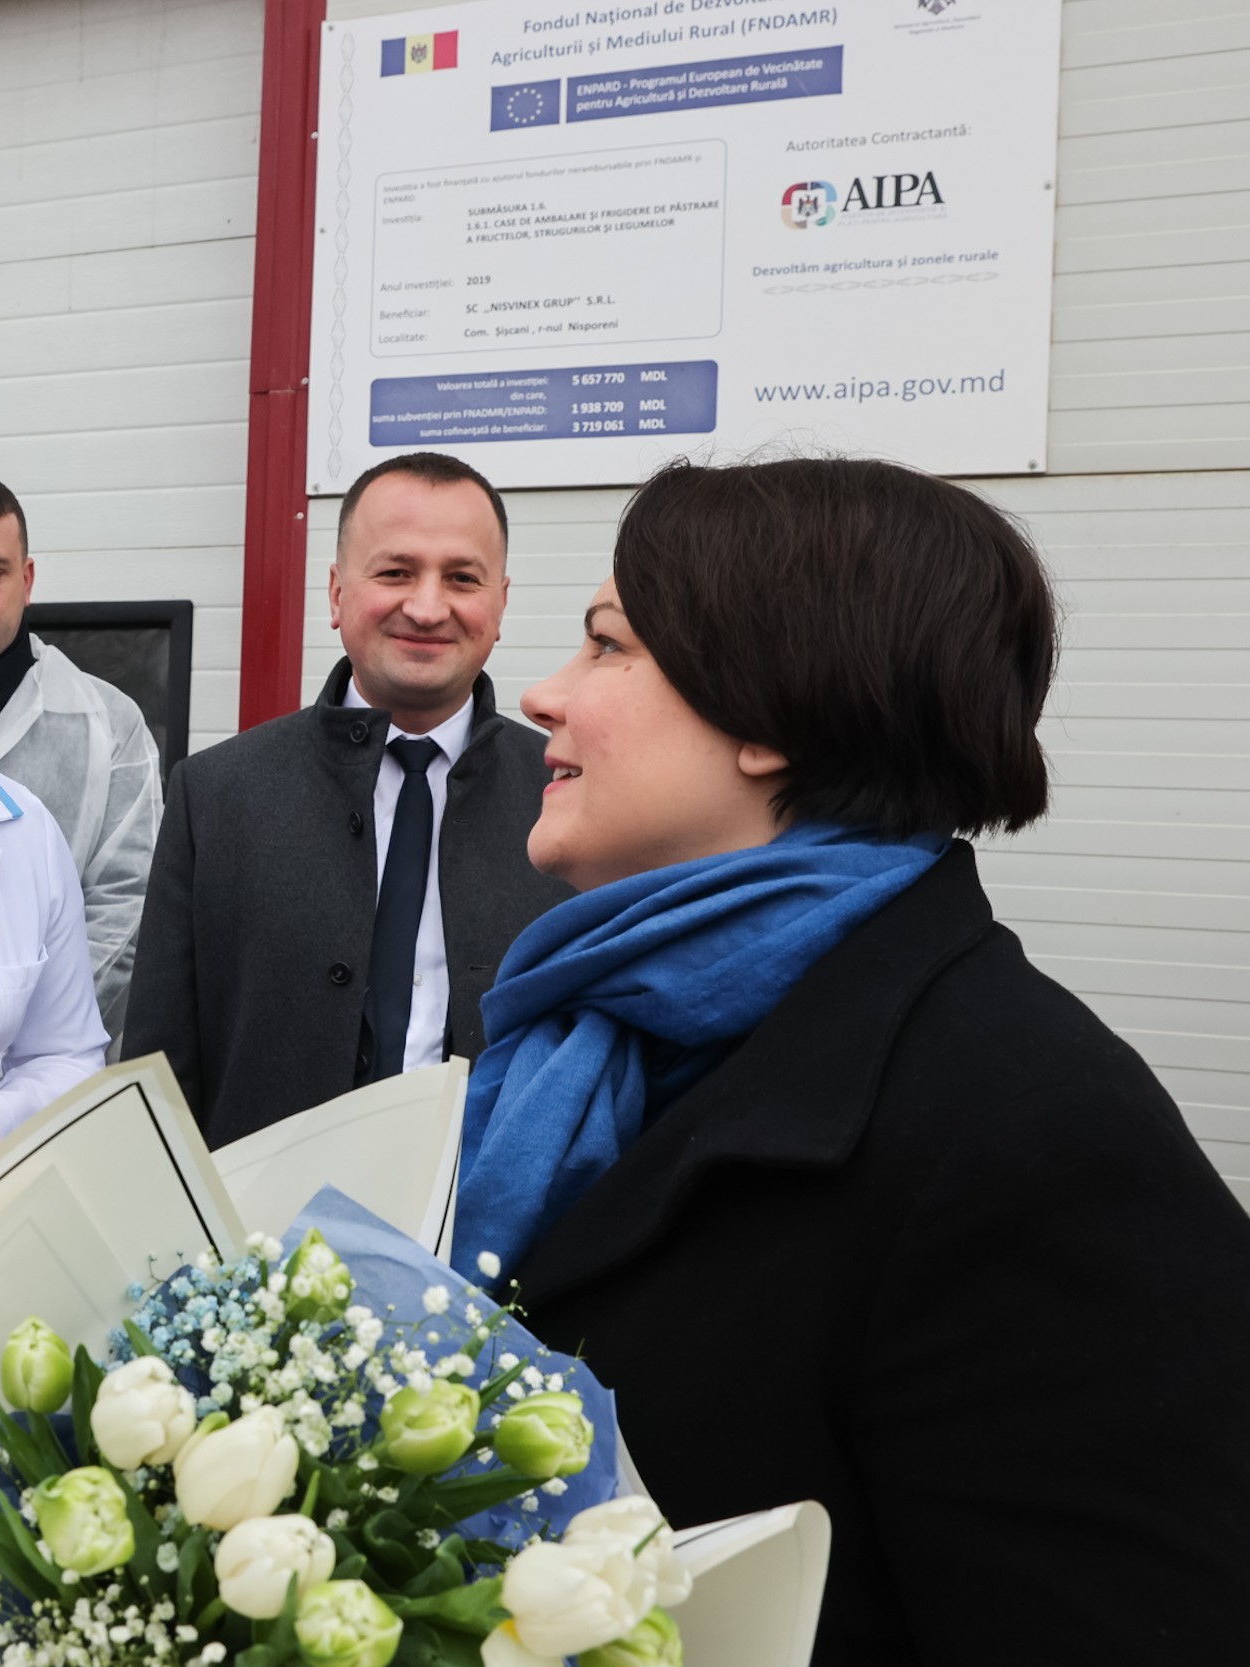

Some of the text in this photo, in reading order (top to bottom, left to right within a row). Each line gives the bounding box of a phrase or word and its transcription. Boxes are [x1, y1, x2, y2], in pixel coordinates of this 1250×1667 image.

[523, 13, 580, 34] Fondul
[664, 1, 684, 15] de
[491, 40, 583, 67] Agriculturii
[605, 26, 684, 50] Mediului
[689, 20, 735, 40] Rural
[741, 8, 838, 36] (FNDAMR)
[576, 80, 622, 97] ENPARD
[630, 72, 687, 90] Programul
[688, 67, 743, 84] European
[745, 64, 760, 78] de
[761, 58, 824, 75] Vecinătate
[576, 98, 613, 113] pentru
[614, 89, 675, 108] Agricultură
[688, 82, 748, 99] Dezvoltare
[750, 76, 788, 92] Rurală
[785, 123, 972, 152] Autoritatea Contractantă:
[841, 171, 945, 212] AIPA
[468, 202, 528, 217] SUBMĂSURA
[494, 217, 516, 228] CASE
[519, 217, 532, 226] DE
[534, 211, 587, 225] AMBALARE
[600, 205, 650, 219] FRIGIDERE
[654, 204, 667, 215] DE
[670, 199, 719, 213] PĂSTRARE
[466, 235, 473, 244] A
[476, 231, 531, 243] FRUCTELOR,
[534, 224, 601, 239] STRUGURILOR
[614, 218, 675, 232] LEGUMELOR
[752, 262, 819, 277] Dezvoltăm
[823, 255, 893, 274] agricultura
[911, 253, 955, 266] zonele
[958, 249, 999, 263] rurale
[380, 282, 402, 292] Anul
[466, 275, 492, 286] 2019
[379, 308, 430, 320] Beneficiar:
[465, 304, 479, 314] SC
[586, 295, 615, 306] S.R.L.
[379, 333, 427, 345] Localitate:
[464, 327, 489, 338] Com.
[538, 322, 562, 333] r-nul
[568, 318, 619, 332] Nisporeni
[436, 379, 472, 391] Valoarea
[474, 377, 498, 389] totală
[571, 374, 579, 386] 5
[581, 373, 602, 385] 657
[604, 372, 625, 384] 770
[640, 370, 668, 382] MDL
[754, 368, 1005, 403] www.aipa.gov.md
[510, 390, 524, 401] din
[372, 414, 395, 423] suma
[443, 408, 461, 421] prin
[571, 403, 578, 414] 1
[580, 402, 601, 414] 938
[603, 401, 624, 413] 709
[639, 400, 667, 411] MDL
[420, 428, 441, 437] suma
[490, 424, 501, 434] de
[503, 421, 547, 434] beneficiar:
[572, 421, 580, 432] 3
[582, 420, 602, 432] 719
[604, 420, 625, 431] 061
[639, 418, 666, 430] MDL
